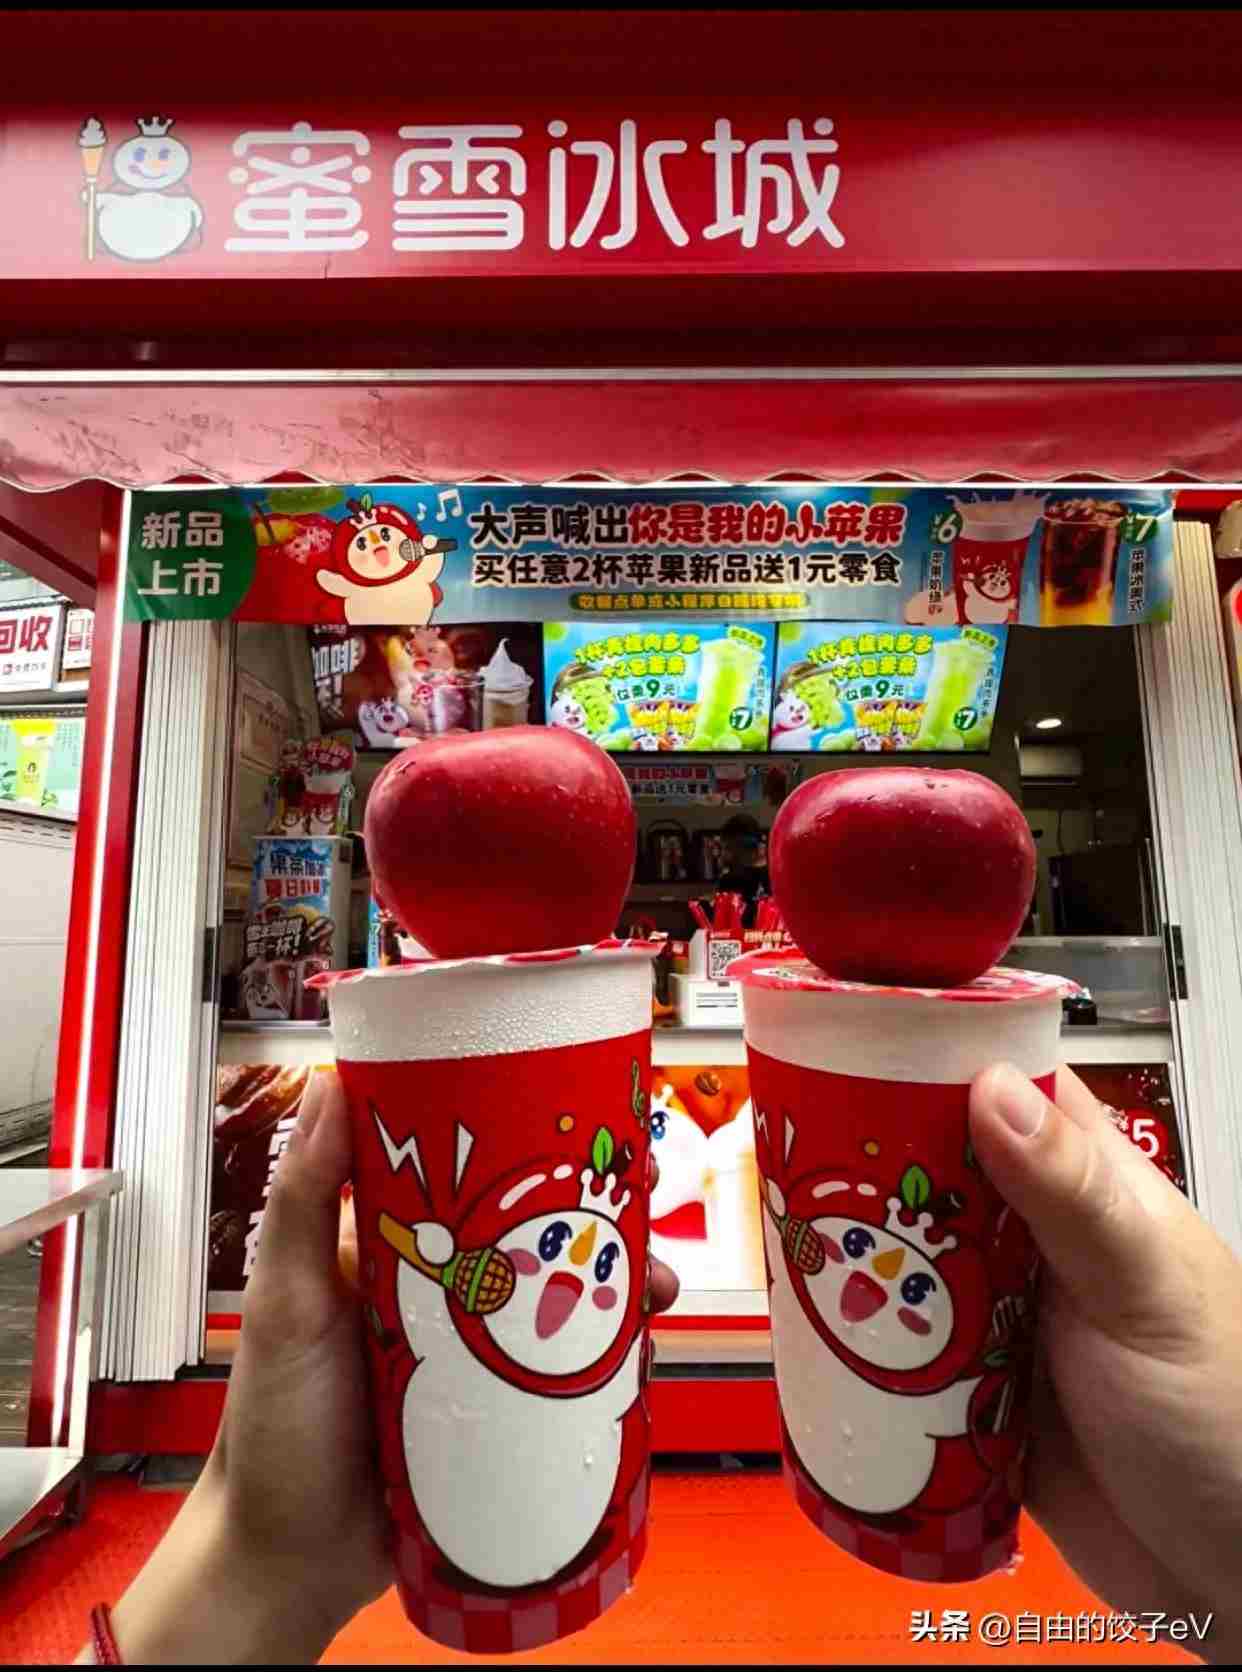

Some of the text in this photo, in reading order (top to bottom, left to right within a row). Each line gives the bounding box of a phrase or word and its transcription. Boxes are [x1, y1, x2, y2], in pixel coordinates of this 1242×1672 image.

[224, 118, 845, 252] 蜜雪冰城
[140, 510, 225, 550] 新品
[470, 502, 909, 551] 大声喊出你是我的小苹果
[138, 558, 224, 598] 上市
[472, 552, 902, 588] 买任意2杯苹果新品送1元零食
